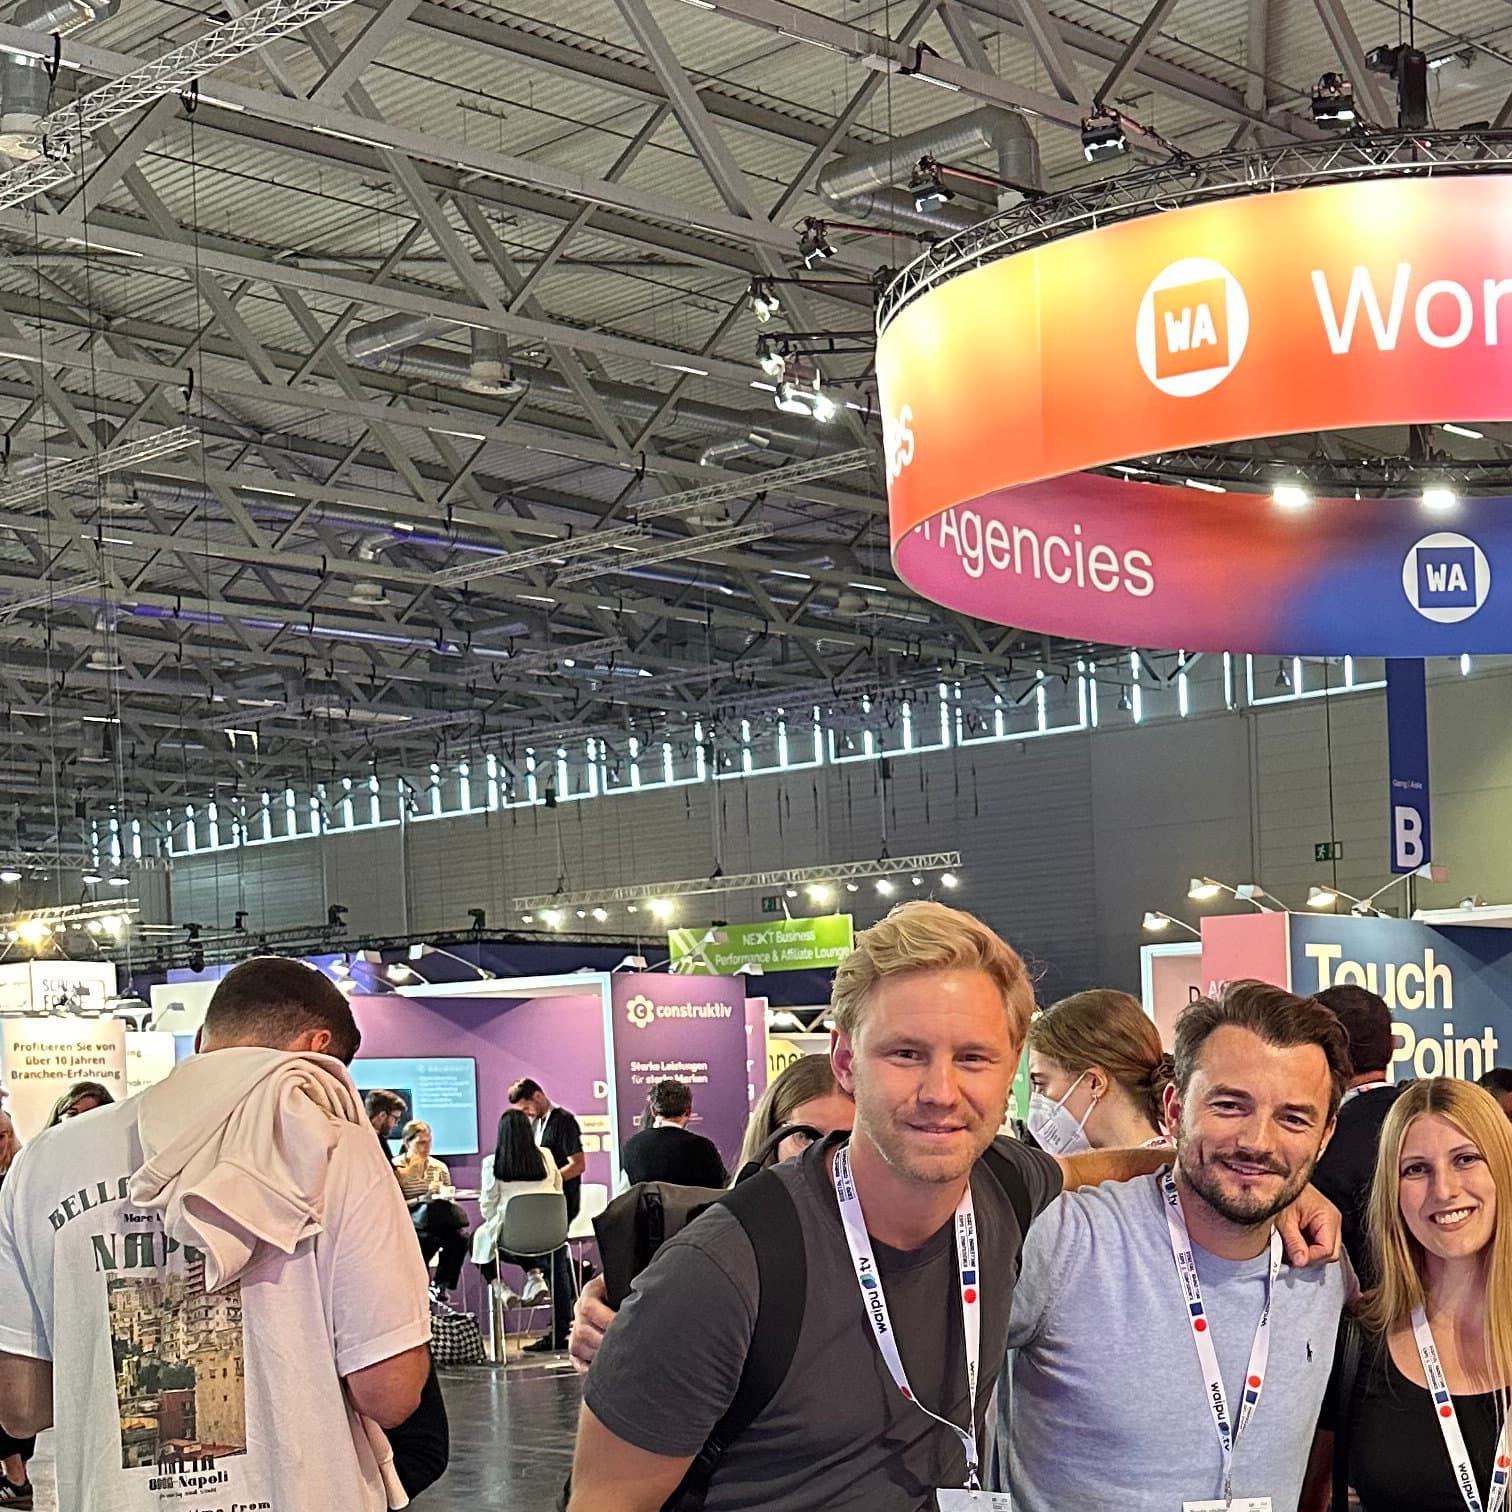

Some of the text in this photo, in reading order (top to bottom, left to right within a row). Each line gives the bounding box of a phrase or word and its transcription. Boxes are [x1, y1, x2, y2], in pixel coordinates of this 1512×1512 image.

[1164, 303, 1217, 354] WA
[939, 508, 1155, 598] Agencies
[1427, 564, 1467, 592] WA
[1395, 806, 1424, 868] B
[776, 929, 816, 943] Business
[715, 952, 771, 967] Performance
[815, 946, 851, 961] Lounge
[1305, 943, 1453, 1010] Touch
[656, 1003, 732, 1018] construktiv
[13, 1042, 116, 1052] Profitieren Sie von
[26, 1056, 106, 1066] über 10 Jahren
[1387, 1022, 1498, 1083] Point
[11, 1069, 121, 1080] Branchen-Erfahrung
[632, 1075, 645, 1085] für
[48, 1175, 132, 1232] BELLA
[868, 1289, 887, 1335] waipu
[1209, 1381, 1226, 1424] waipu
[1458, 1461, 1476, 1500] waipu
